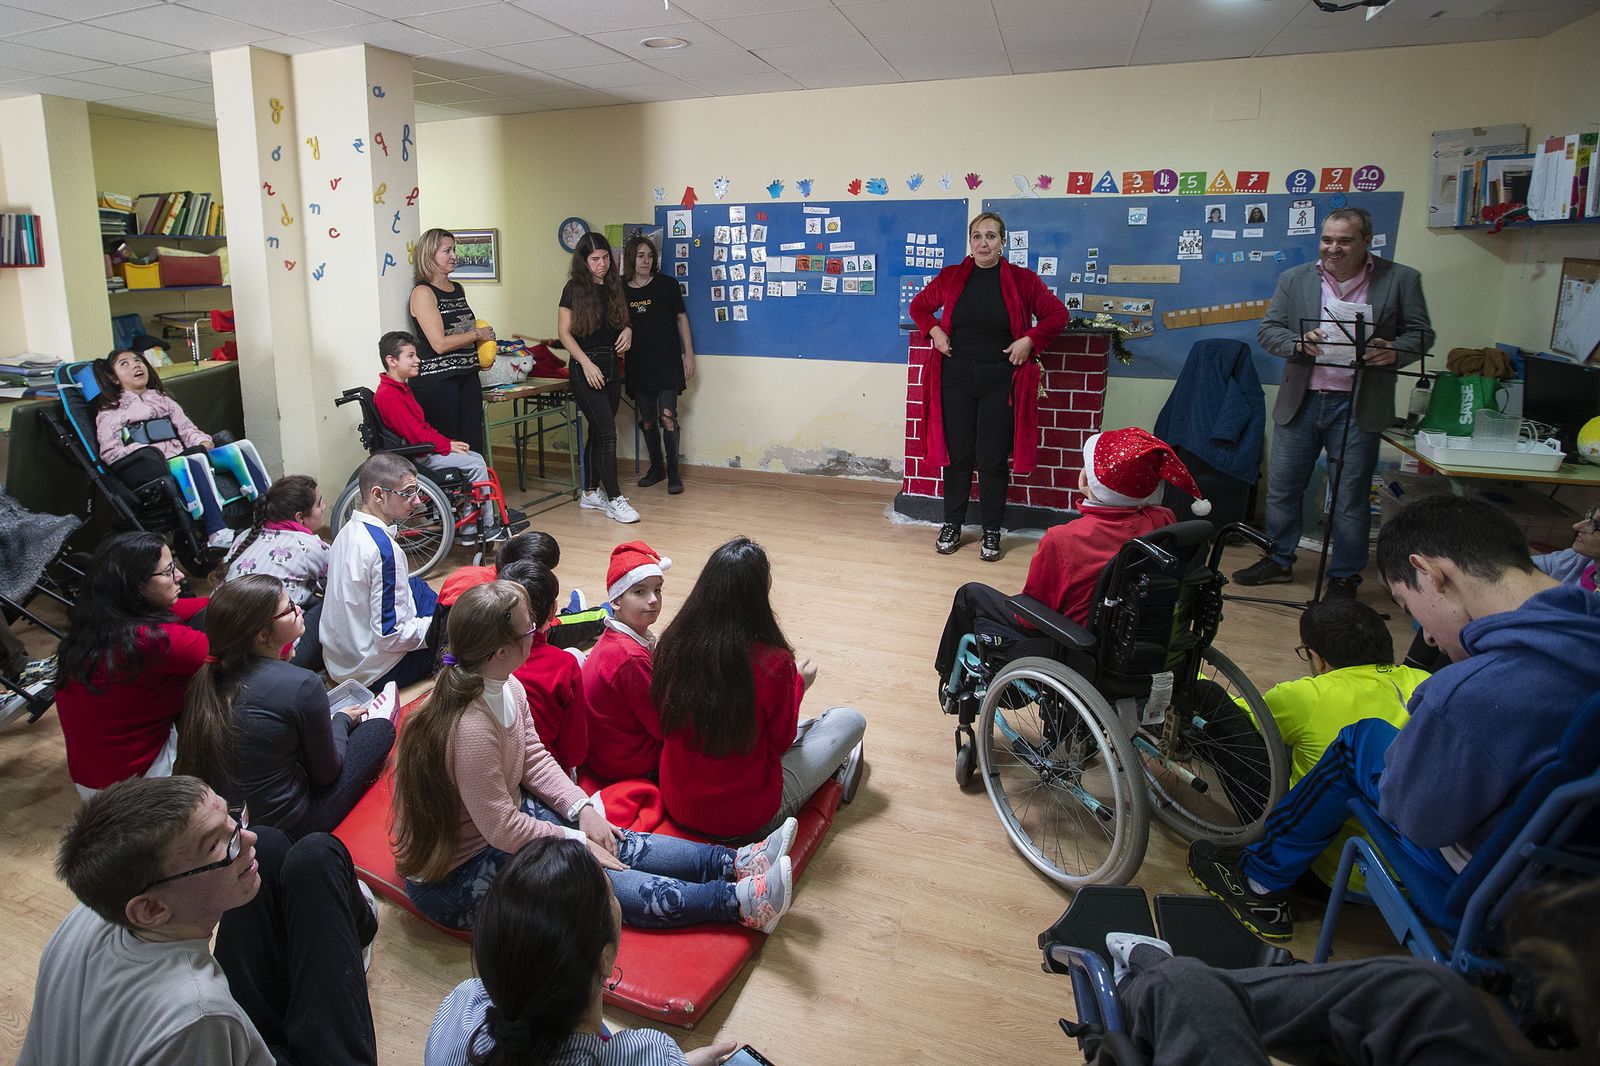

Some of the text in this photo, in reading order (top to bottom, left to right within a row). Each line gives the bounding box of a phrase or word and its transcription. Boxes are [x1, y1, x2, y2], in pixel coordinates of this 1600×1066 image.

[1076, 175, 1085, 186] 1
[1101, 175, 1112, 187] 2
[1131, 172, 1144, 188] 3
[1159, 172, 1170, 188] 4
[1187, 175, 1198, 188] 5
[1215, 174, 1226, 188] 6
[1247, 173, 1259, 187] 7
[1294, 172, 1307, 186] 8
[1331, 168, 1343, 184] 9
[1358, 168, 1379, 181] 10
[328, 227, 341, 239] c
[816, 241, 824, 250] 4
[1459, 383, 1474, 425] SATSE
